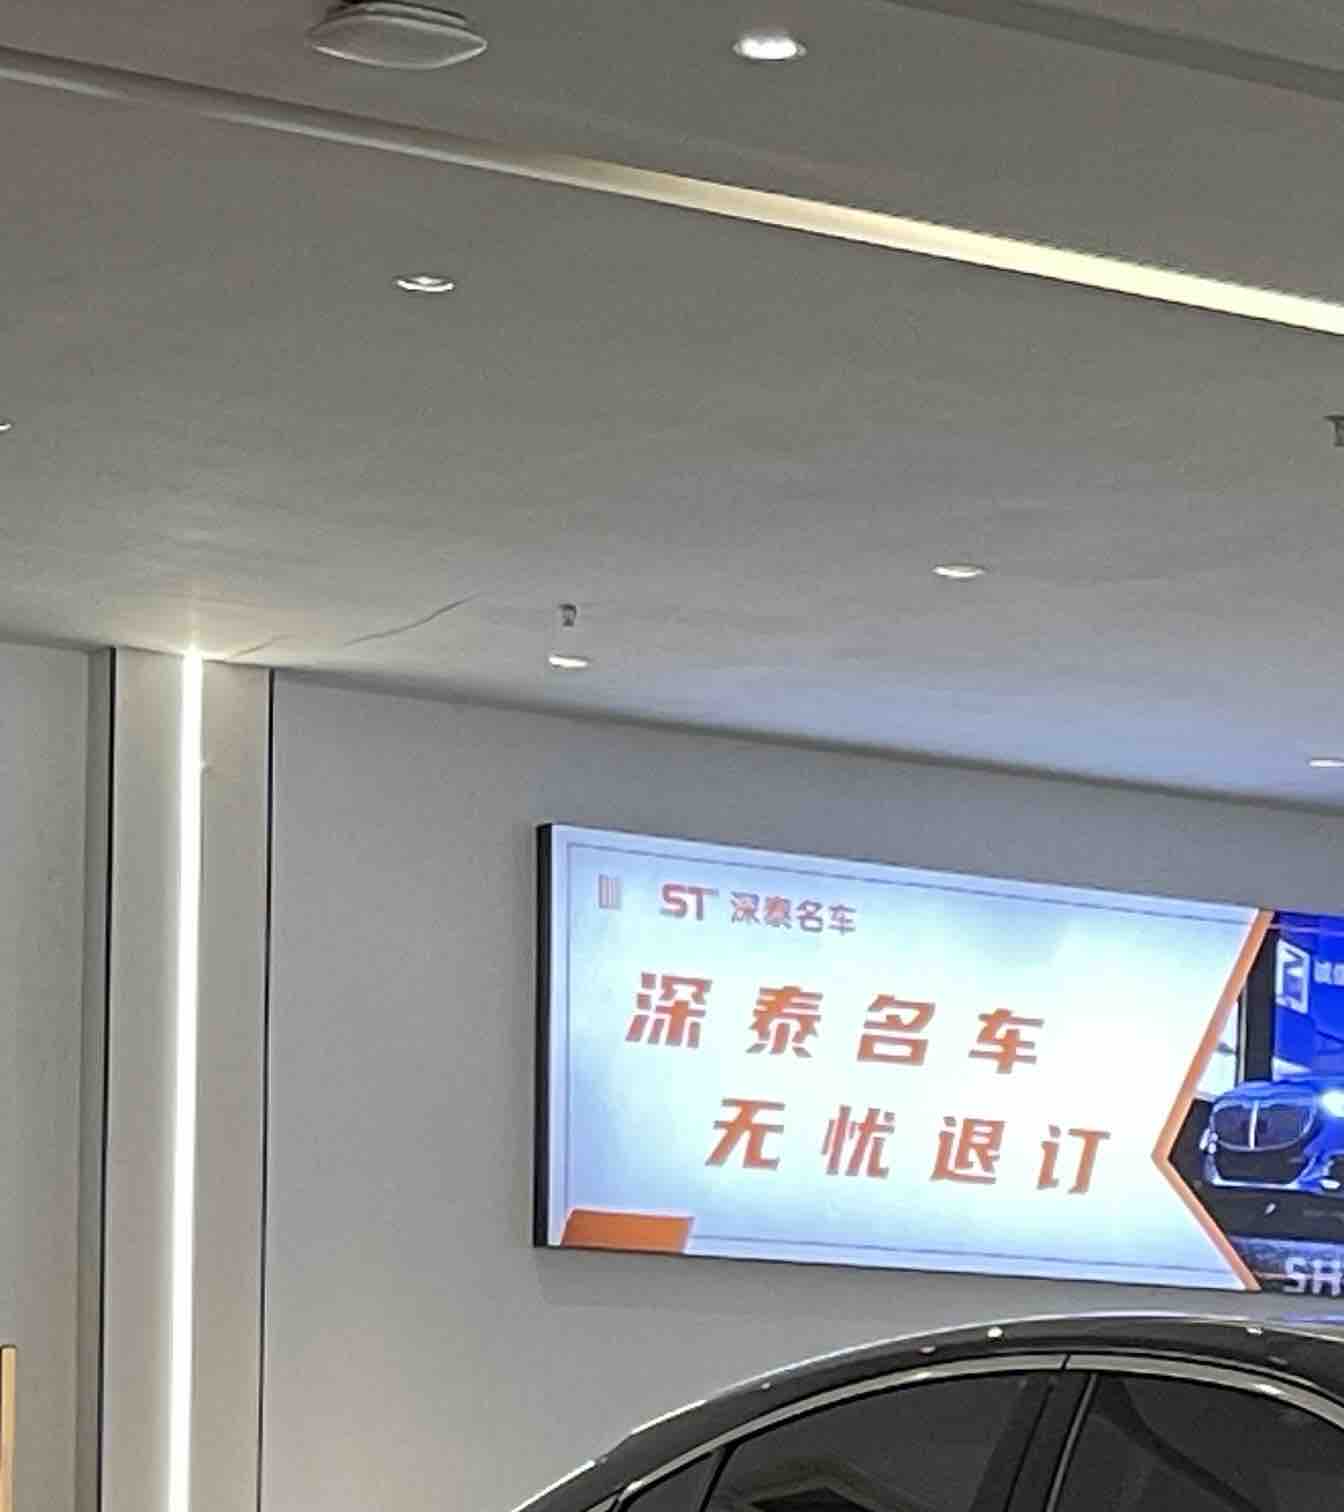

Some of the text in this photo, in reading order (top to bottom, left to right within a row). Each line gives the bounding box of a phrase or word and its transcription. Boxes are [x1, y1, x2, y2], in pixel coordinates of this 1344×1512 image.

[660, 883, 857, 935] ST 深泰名车
[625, 971, 1045, 1074] 深泰名车
[705, 1097, 1112, 1195] 无忧退订
